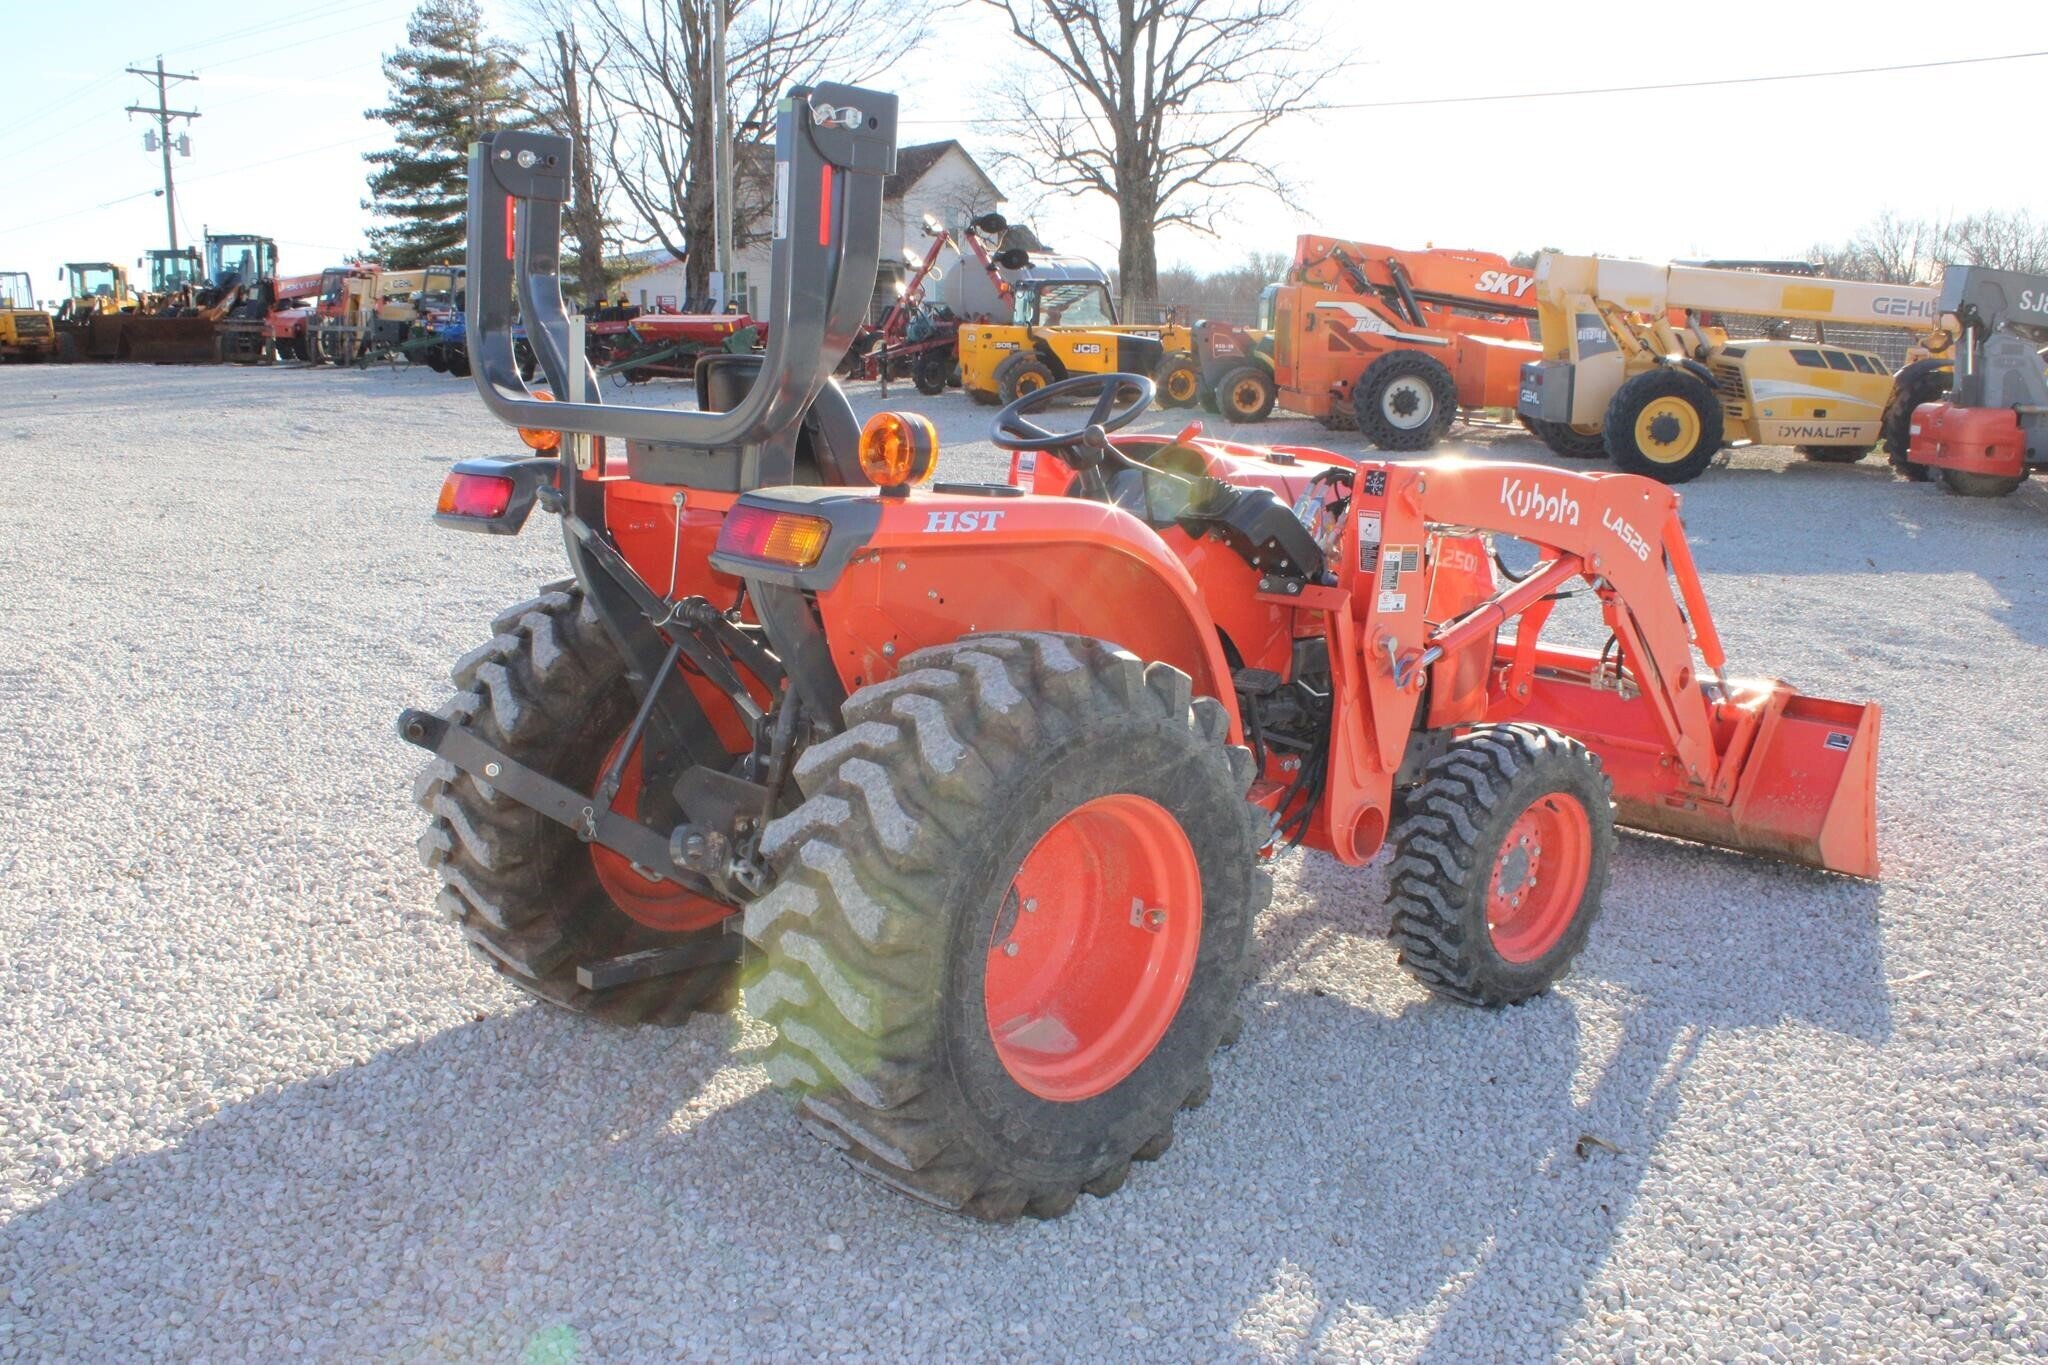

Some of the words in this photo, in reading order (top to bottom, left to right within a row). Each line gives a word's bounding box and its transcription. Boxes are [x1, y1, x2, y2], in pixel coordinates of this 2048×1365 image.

[1474, 270, 1534, 297] SKY
[1073, 344, 1101, 353] JCB
[1778, 426, 1861, 439] DYNALIFT
[1500, 477, 1580, 526] Kubota
[922, 510, 1005, 533] HST
[1602, 507, 1652, 562] LA526
